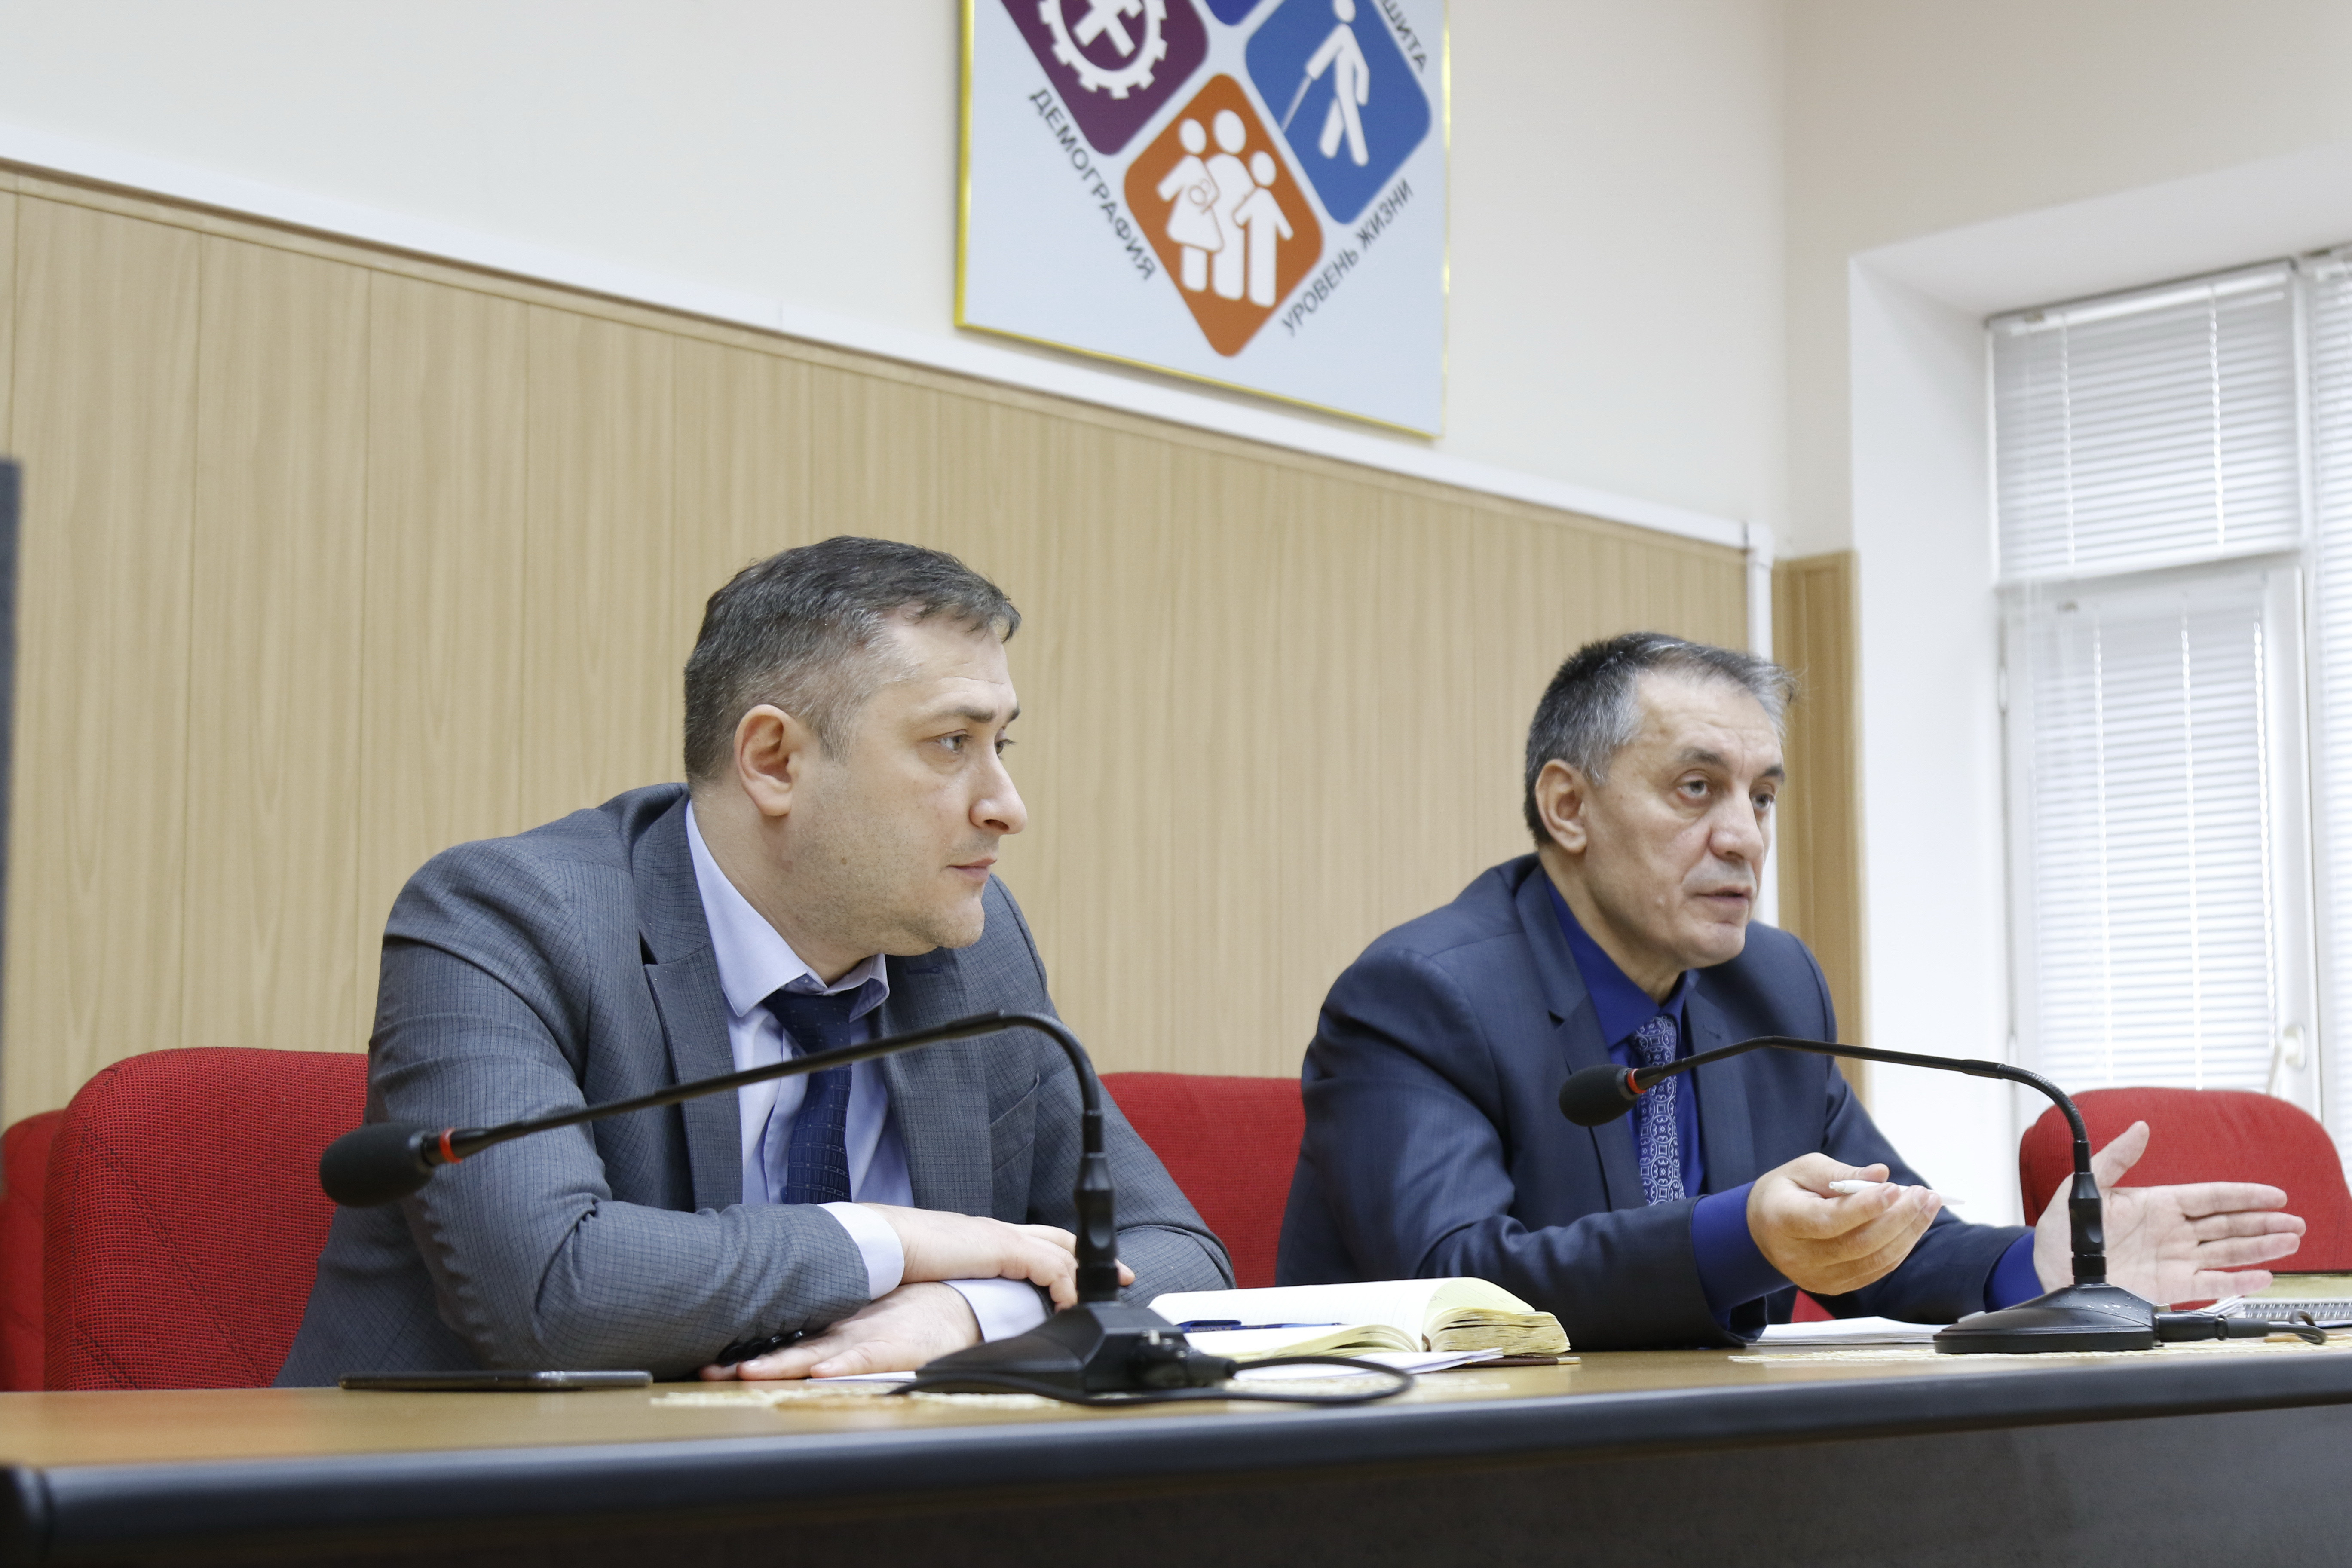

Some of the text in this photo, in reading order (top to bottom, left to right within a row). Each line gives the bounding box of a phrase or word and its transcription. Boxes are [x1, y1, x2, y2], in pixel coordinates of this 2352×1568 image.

[1029, 89, 1156, 280] ДЕМОГРАФИЯ
[1282, 178, 1413, 337] УРОВЕНЬ ЖИЗНИ
